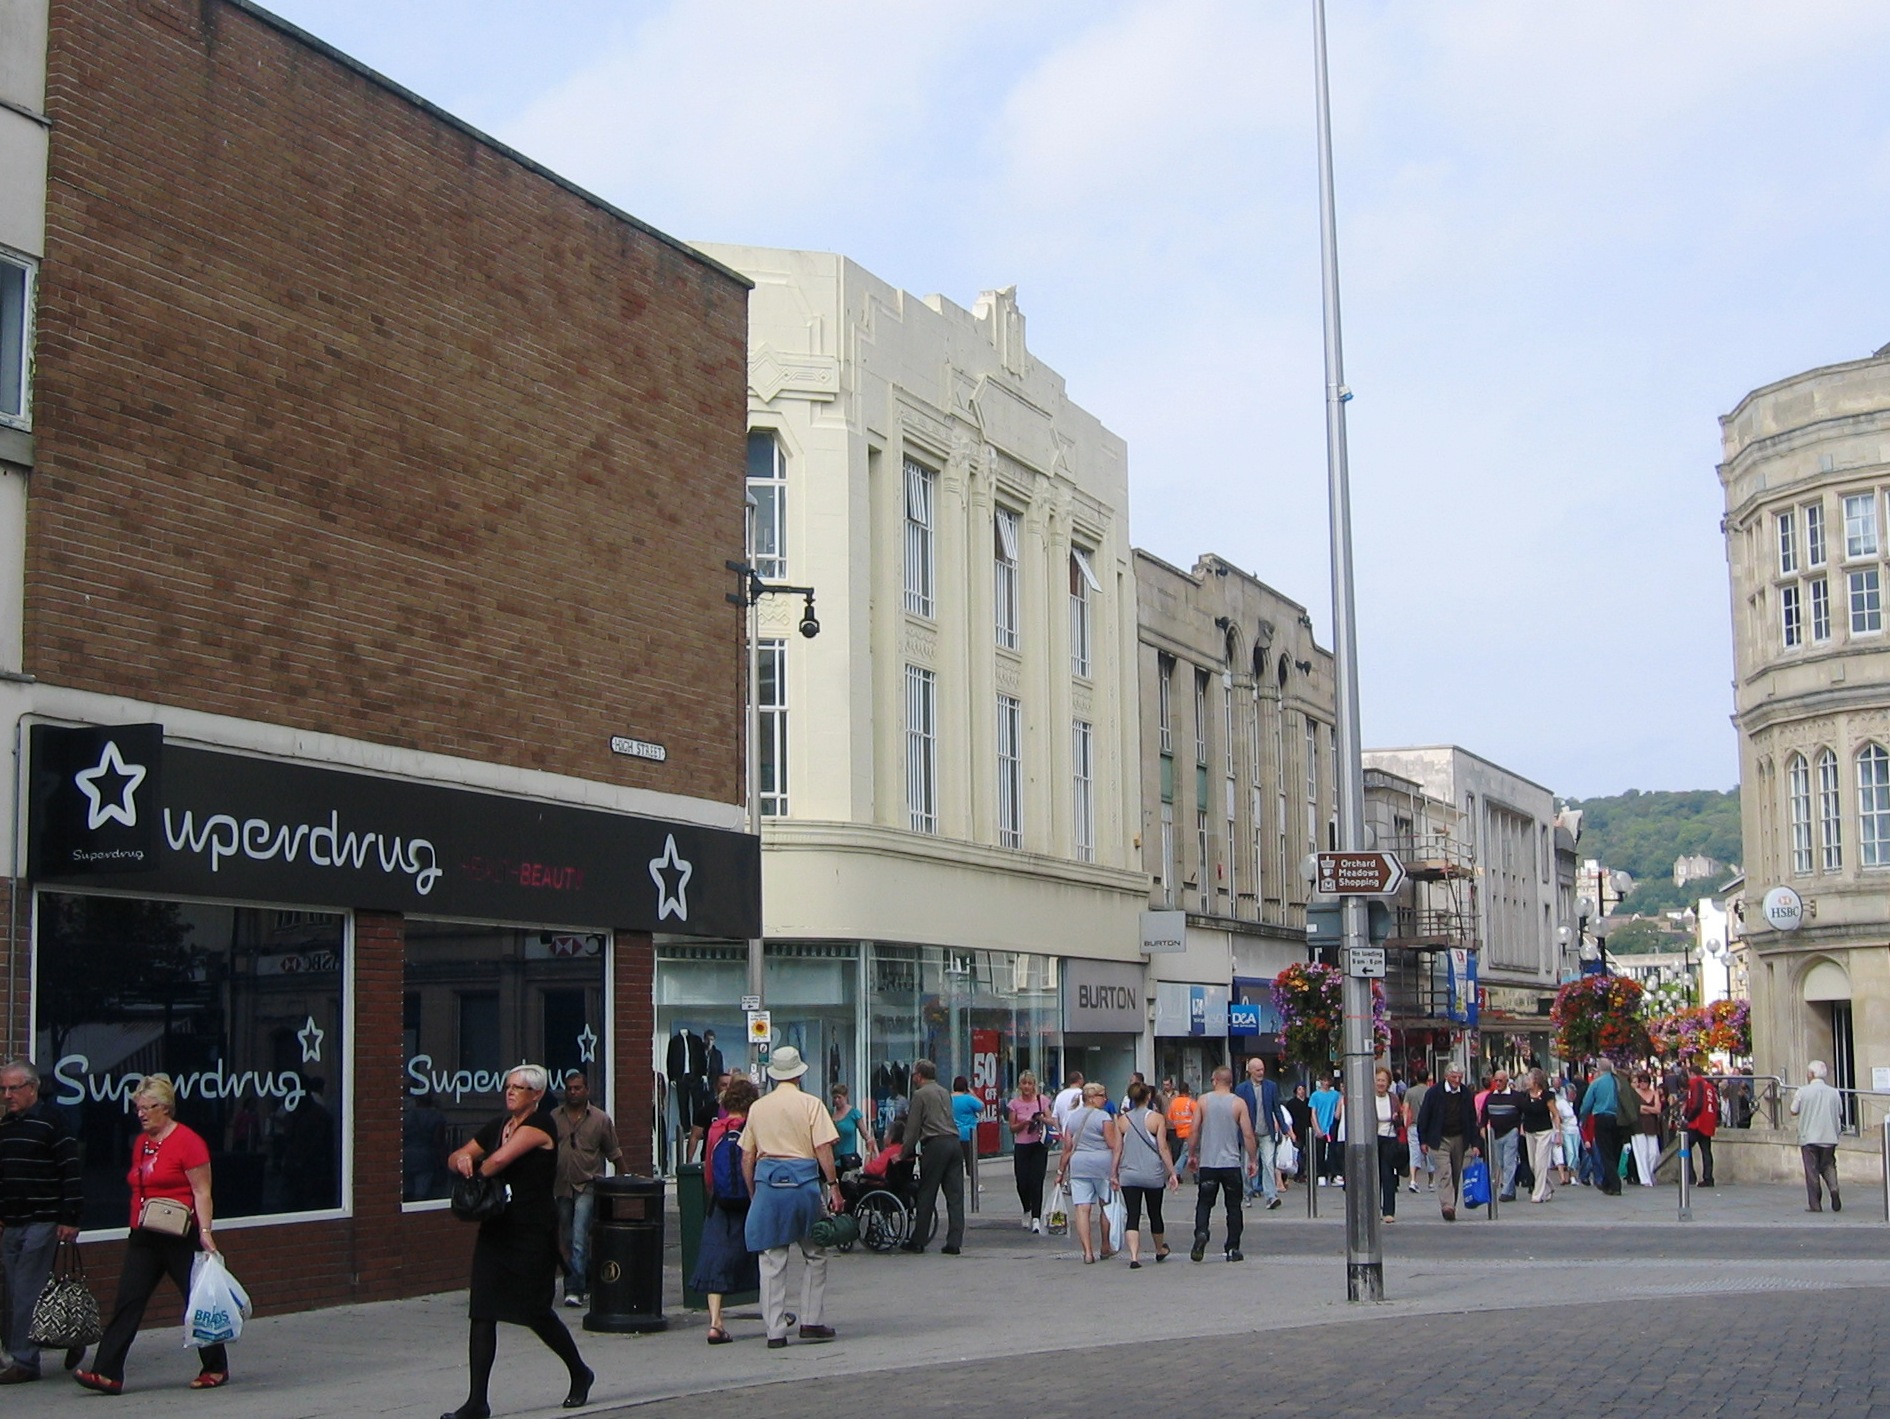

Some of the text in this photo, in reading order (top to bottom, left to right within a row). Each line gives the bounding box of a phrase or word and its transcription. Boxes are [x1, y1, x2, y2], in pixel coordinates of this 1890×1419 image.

[615, 738, 662, 759] HIGH STREET
[72, 848, 145, 862] Superdrug
[163, 807, 443, 896] uperdrug
[1340, 859, 1376, 868] Orchard
[1338, 868, 1380, 877] Meadows
[1338, 877, 1380, 888] Shopping
[1771, 906, 1799, 918] HSBC
[1078, 984, 1137, 1011] BURTON
[1232, 1012, 1257, 1025] D&A
[53, 1053, 306, 1114] Suprdrug
[407, 1053, 580, 1104] Superu
[984, 1087, 997, 1101] OFF
